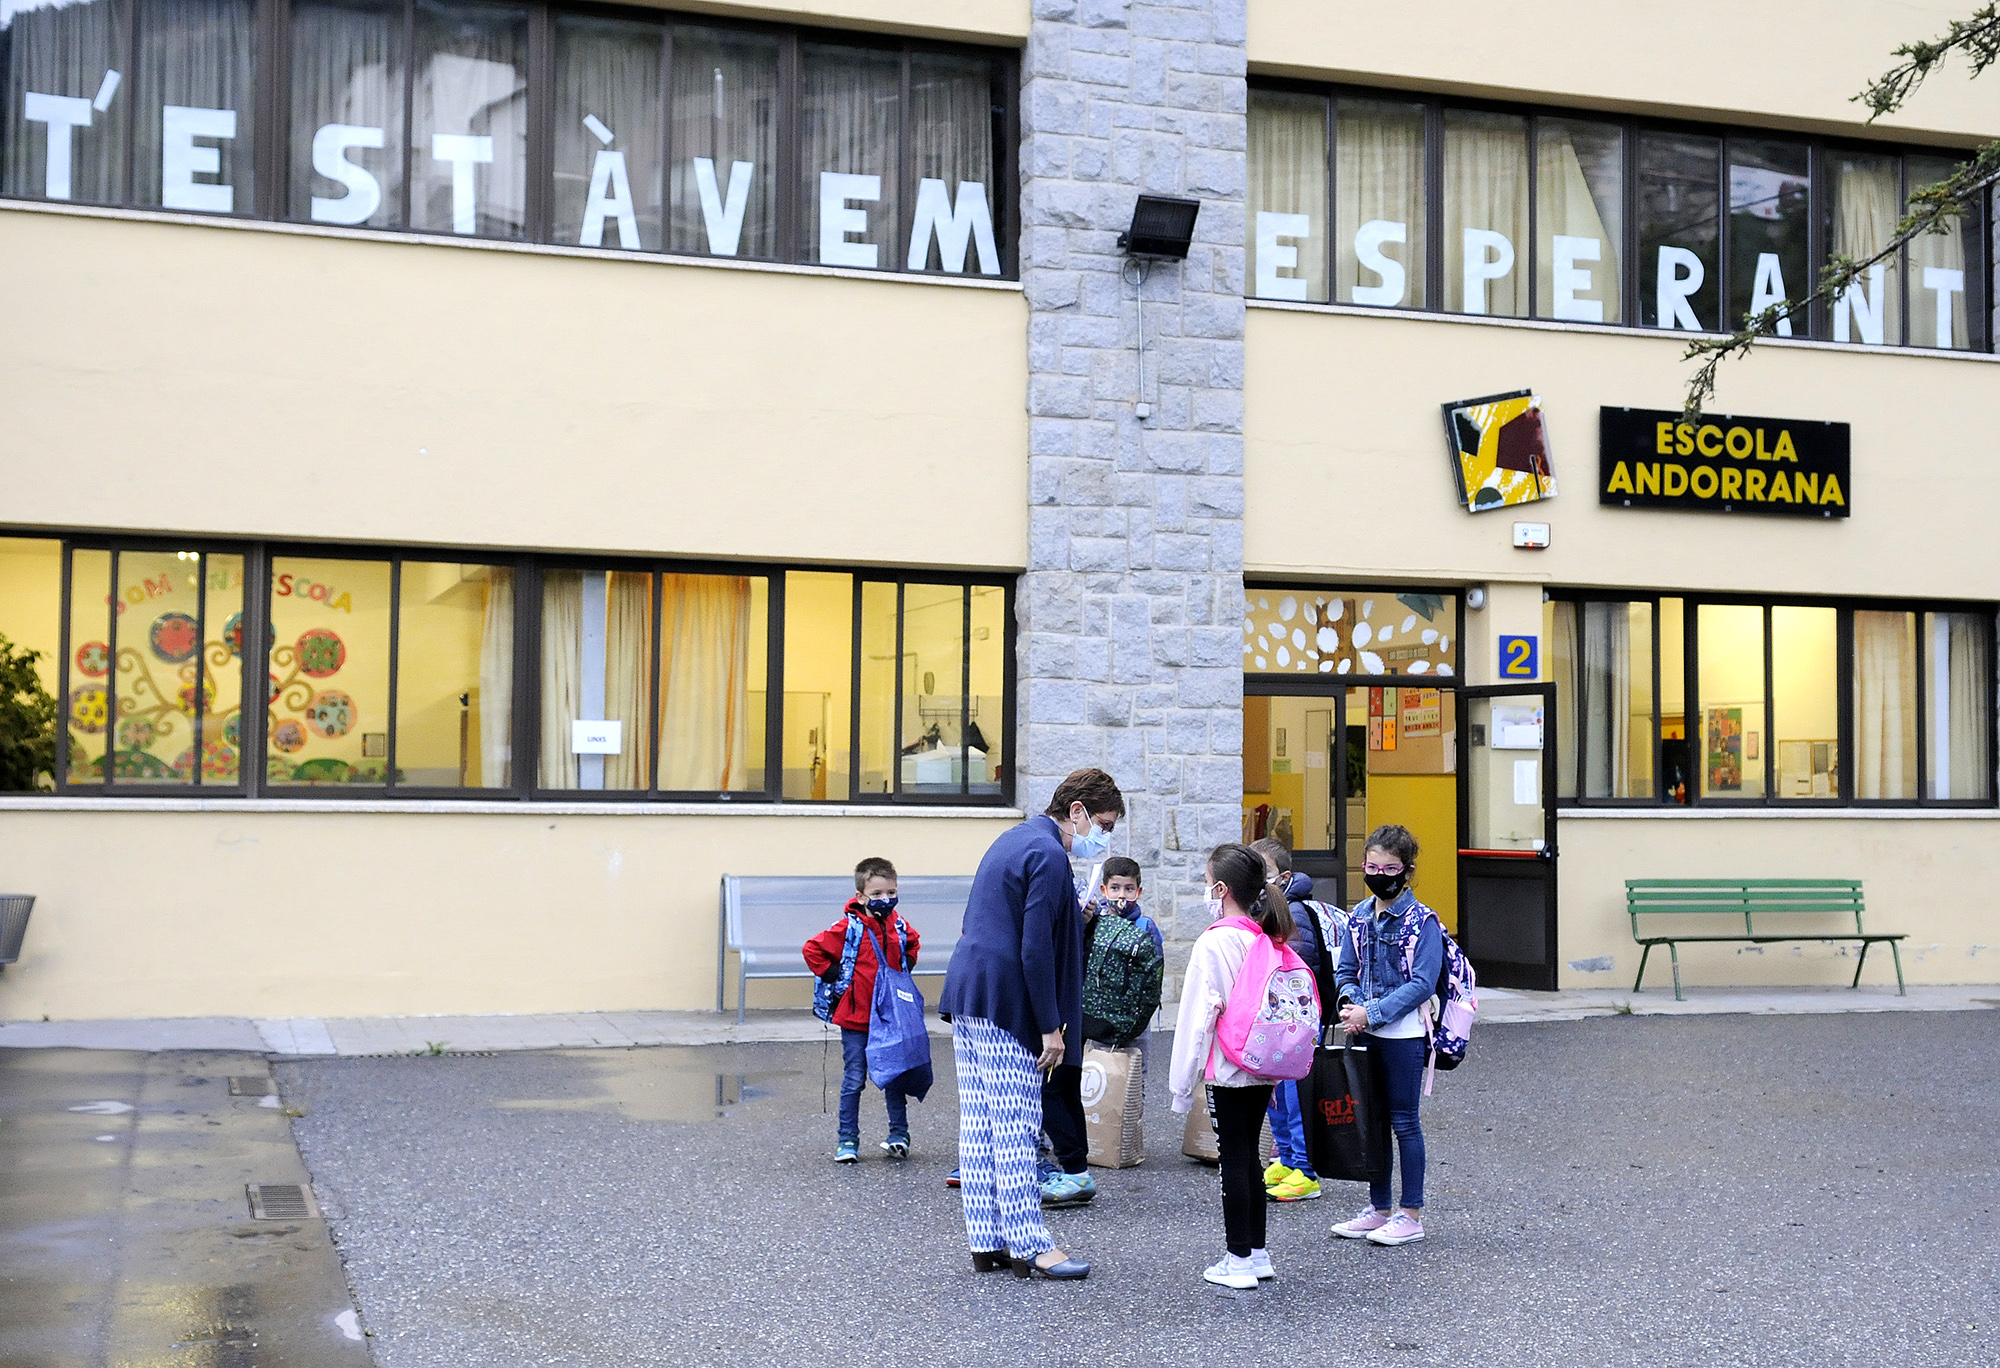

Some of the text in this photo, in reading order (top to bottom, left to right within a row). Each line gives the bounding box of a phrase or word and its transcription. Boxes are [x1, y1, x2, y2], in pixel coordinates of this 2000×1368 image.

[1256, 210, 1965, 349] ESPERANT
[1656, 421, 1799, 463] ESCOLA
[1607, 460, 1845, 506] ANDORRANA
[1506, 638, 1531, 675] 2
